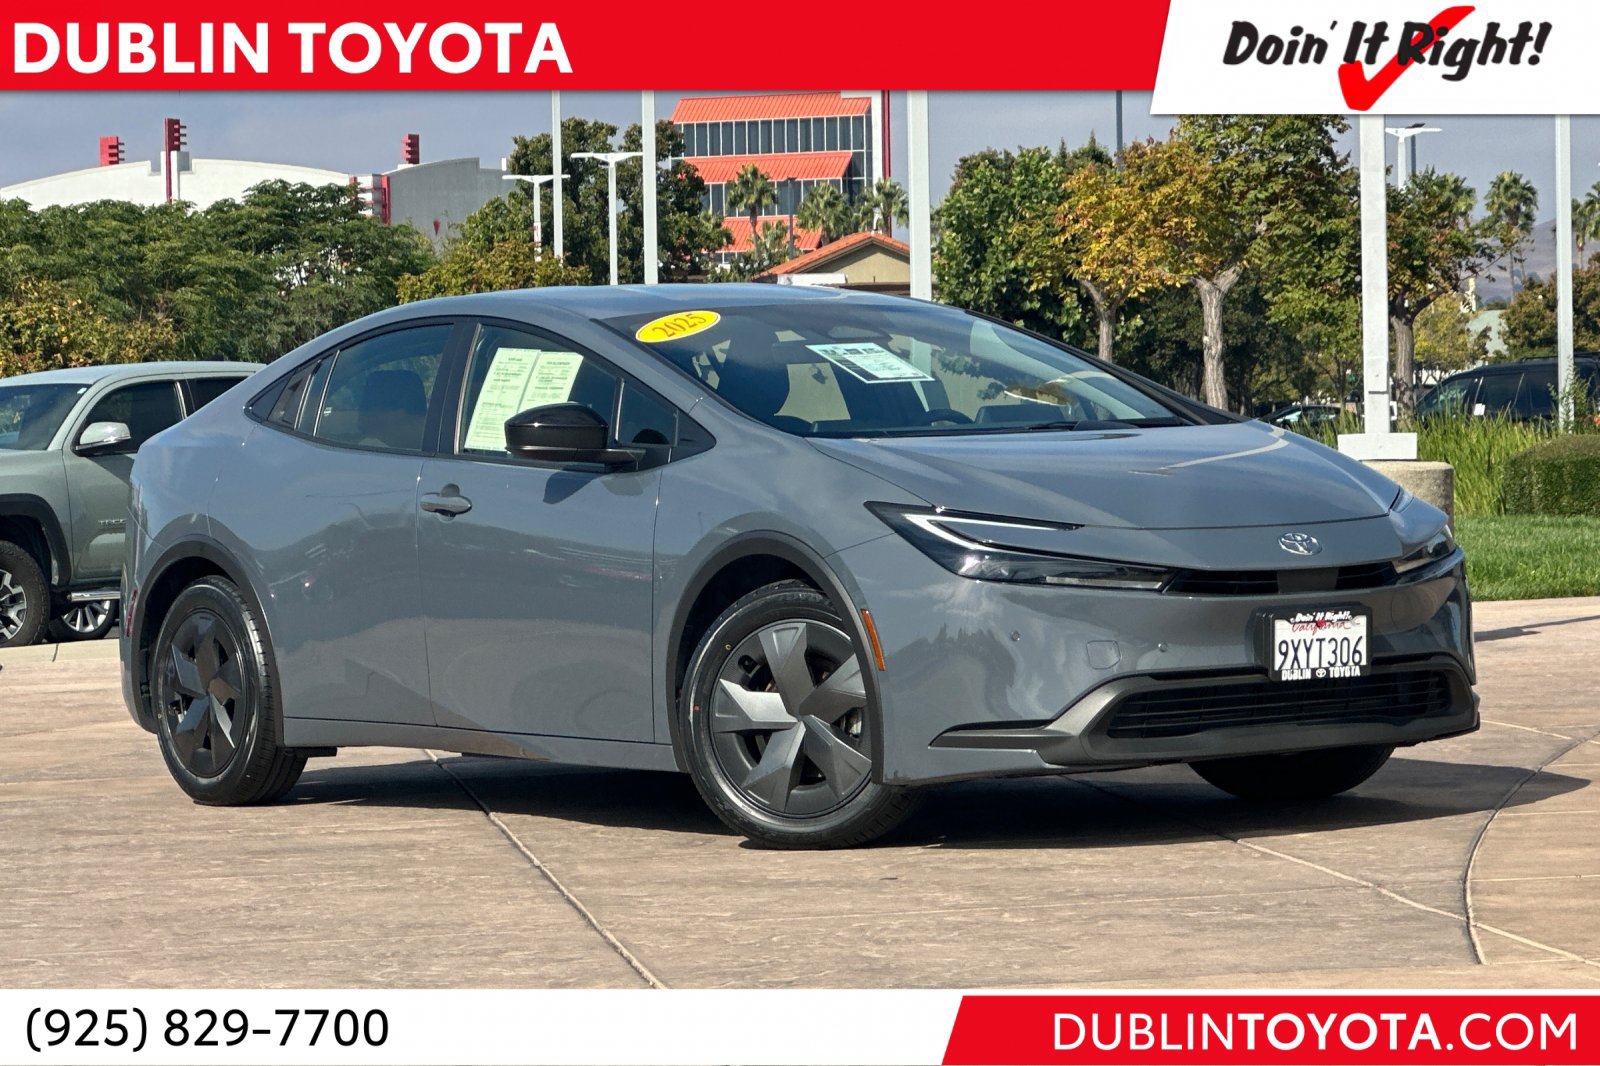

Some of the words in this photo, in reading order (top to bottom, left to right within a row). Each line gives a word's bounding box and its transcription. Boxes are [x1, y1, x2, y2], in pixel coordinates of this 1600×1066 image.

[651, 313, 707, 337] 2025
[1278, 636, 1363, 670] 9XYT306
[1281, 668, 1311, 681] DUBLIN
[1329, 665, 1360, 678] TOYOTA
